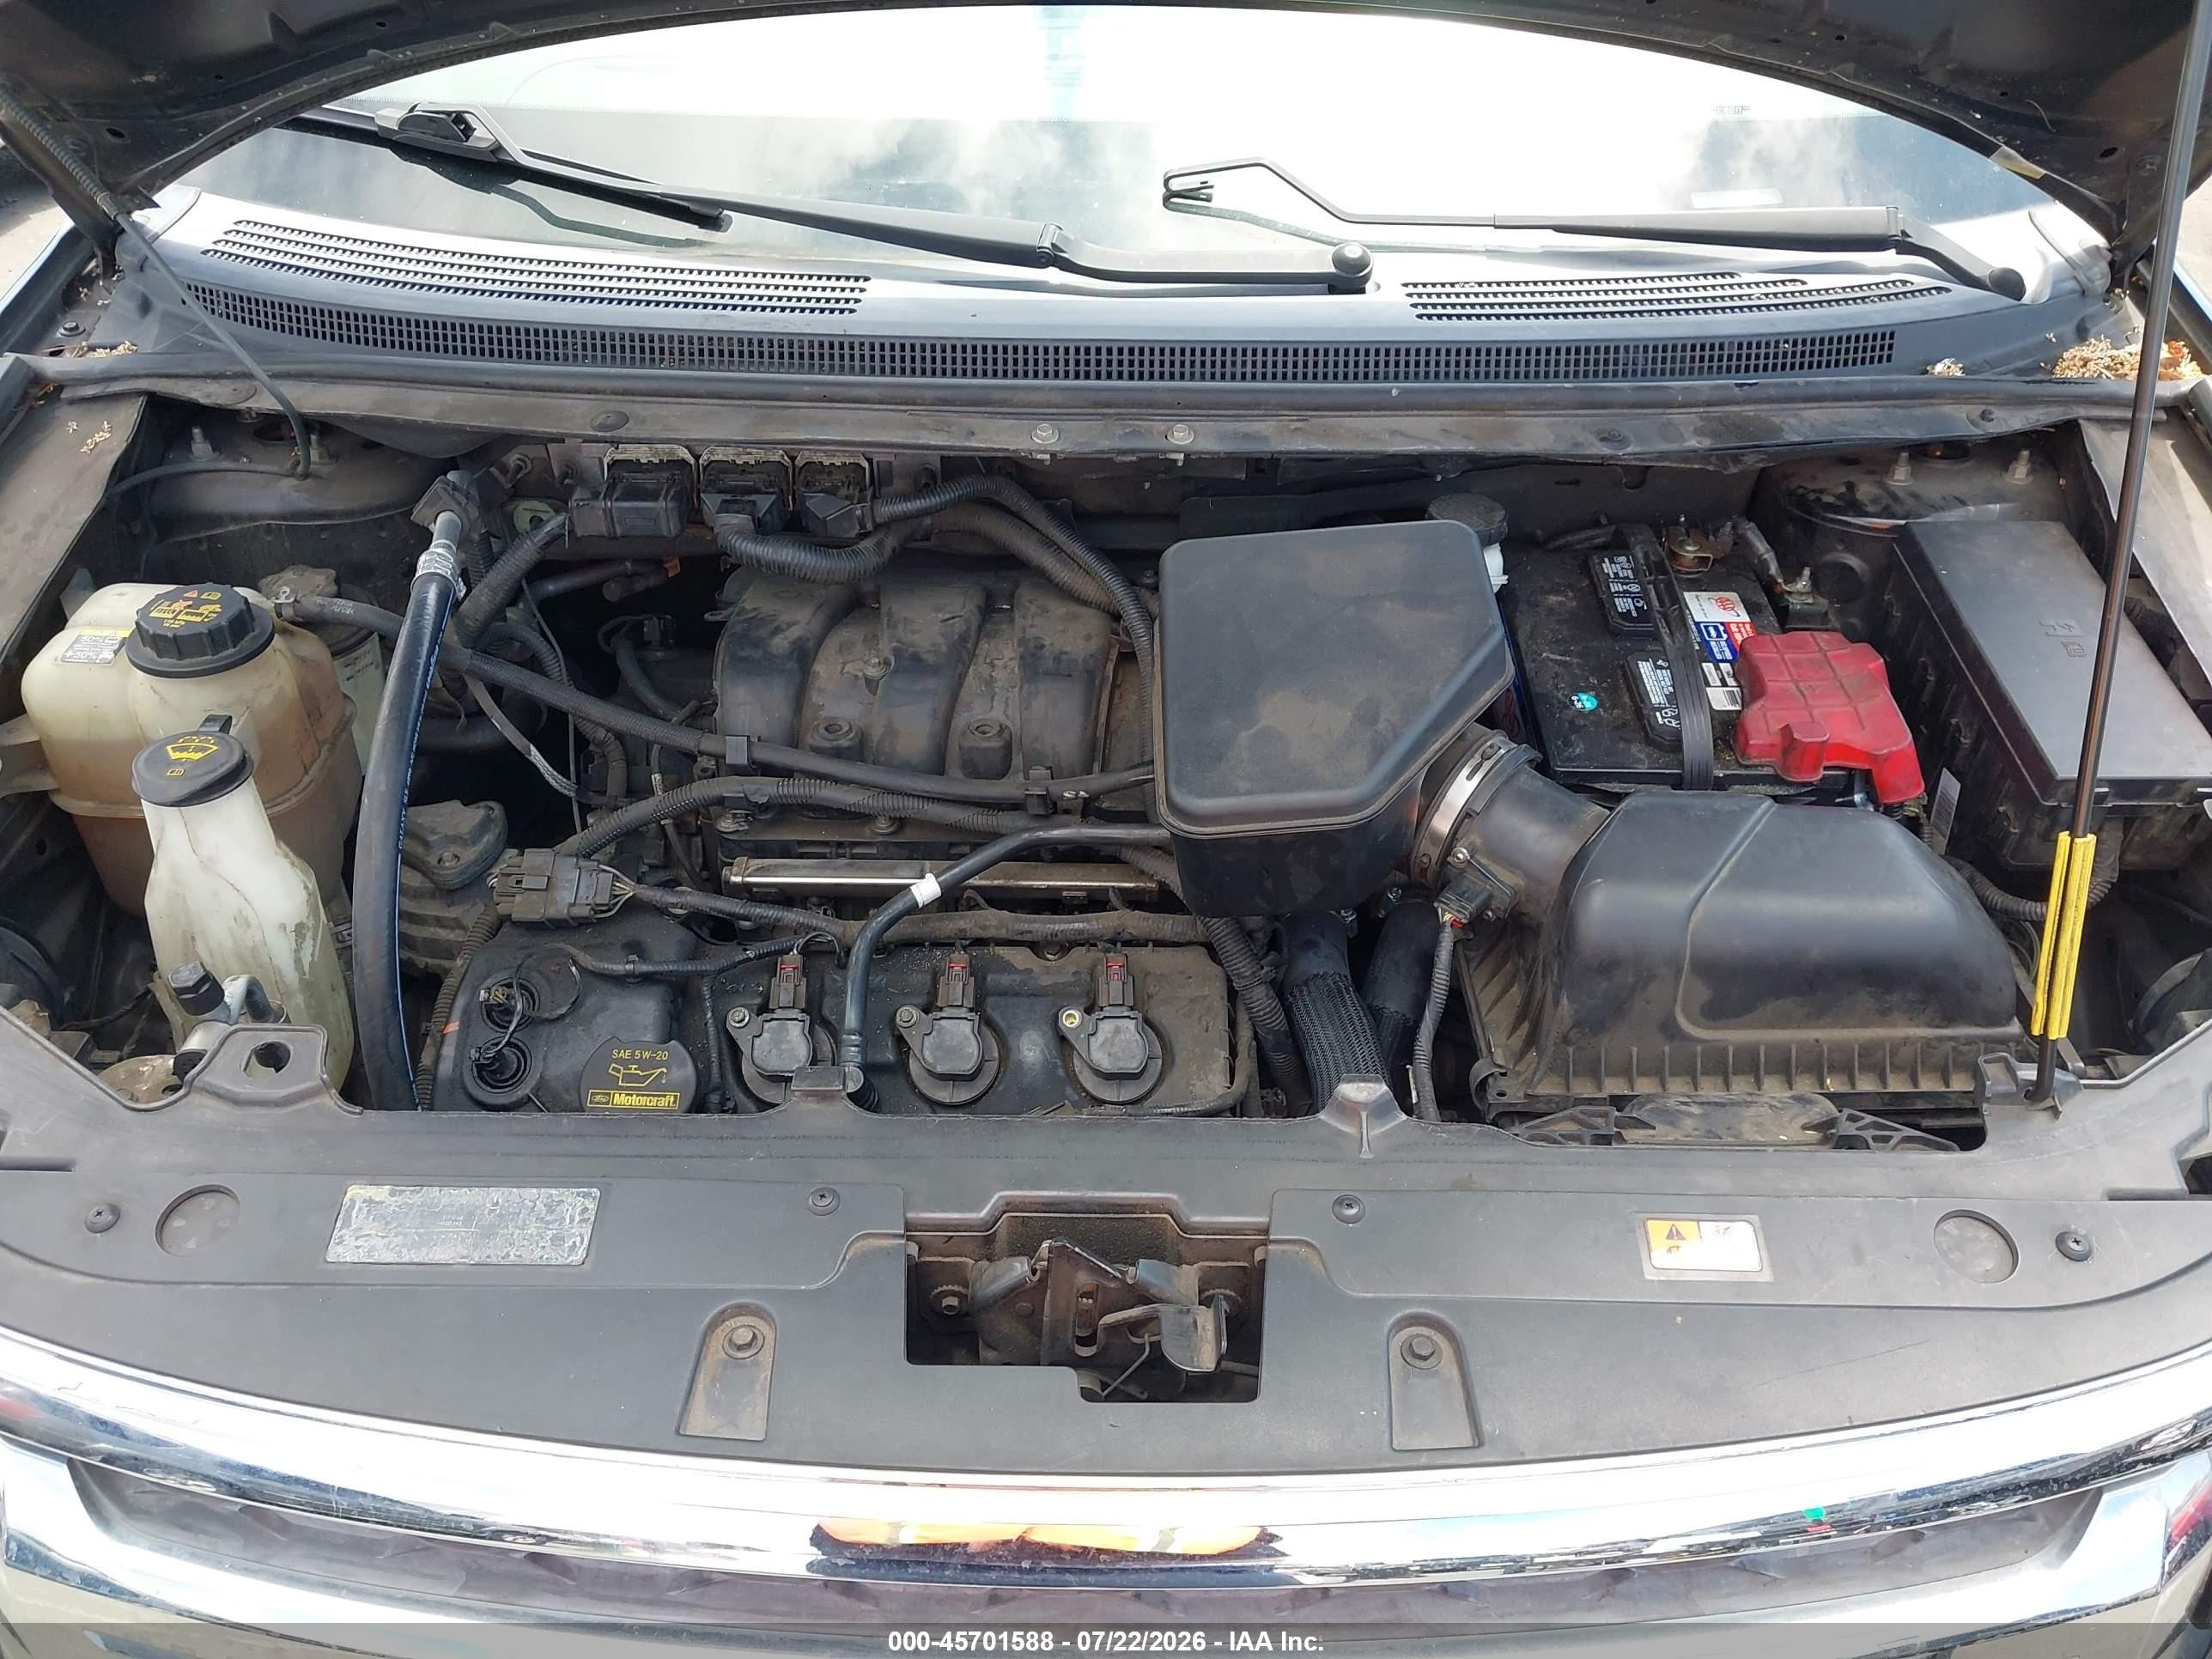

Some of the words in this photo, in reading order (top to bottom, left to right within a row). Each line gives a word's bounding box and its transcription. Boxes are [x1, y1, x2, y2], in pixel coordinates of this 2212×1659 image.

[611, 1049, 632, 1059] SAE
[634, 1050, 669, 1060] 5W-20
[613, 1092, 675, 1107] Motorcraft
